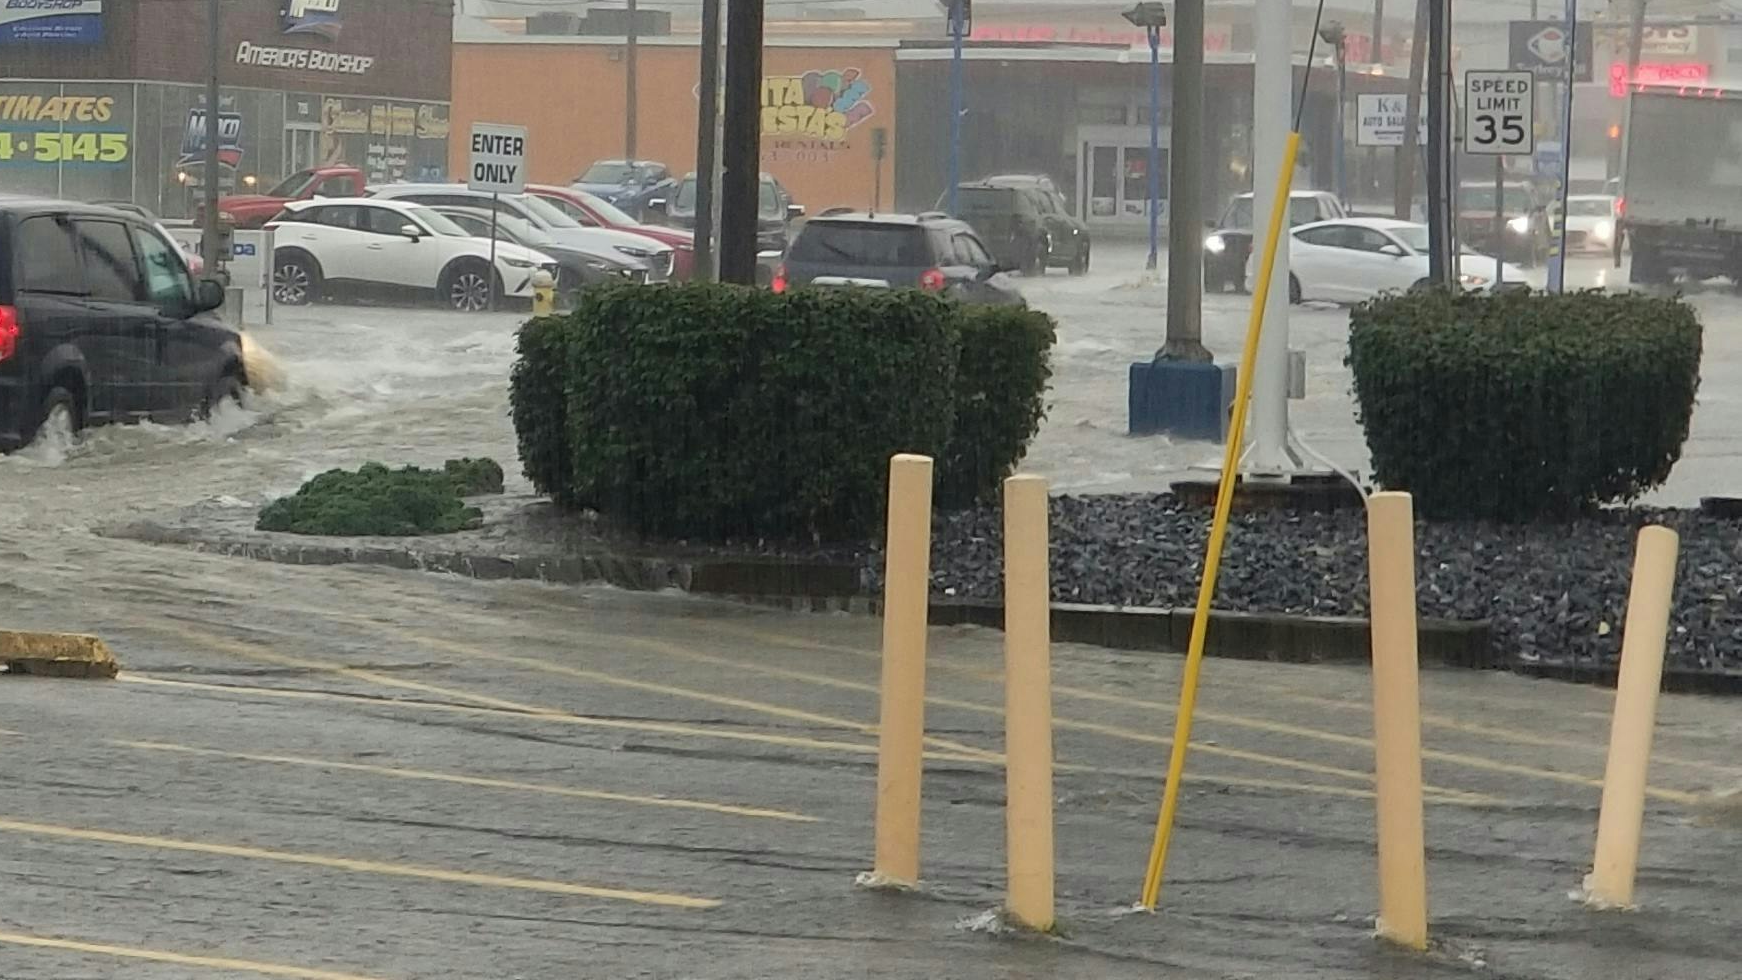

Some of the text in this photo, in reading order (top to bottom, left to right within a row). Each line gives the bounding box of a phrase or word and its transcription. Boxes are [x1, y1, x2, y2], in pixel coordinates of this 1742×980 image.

[308, 49, 374, 74] BODYSHOP
[1471, 79, 1528, 94] SPEED
[1476, 97, 1522, 112] LIMIT
[761, 105, 848, 140] ESTAS
[1473, 114, 1525, 145] 35
[472, 133, 523, 156] ENTER
[474, 162, 517, 184] ONLY
